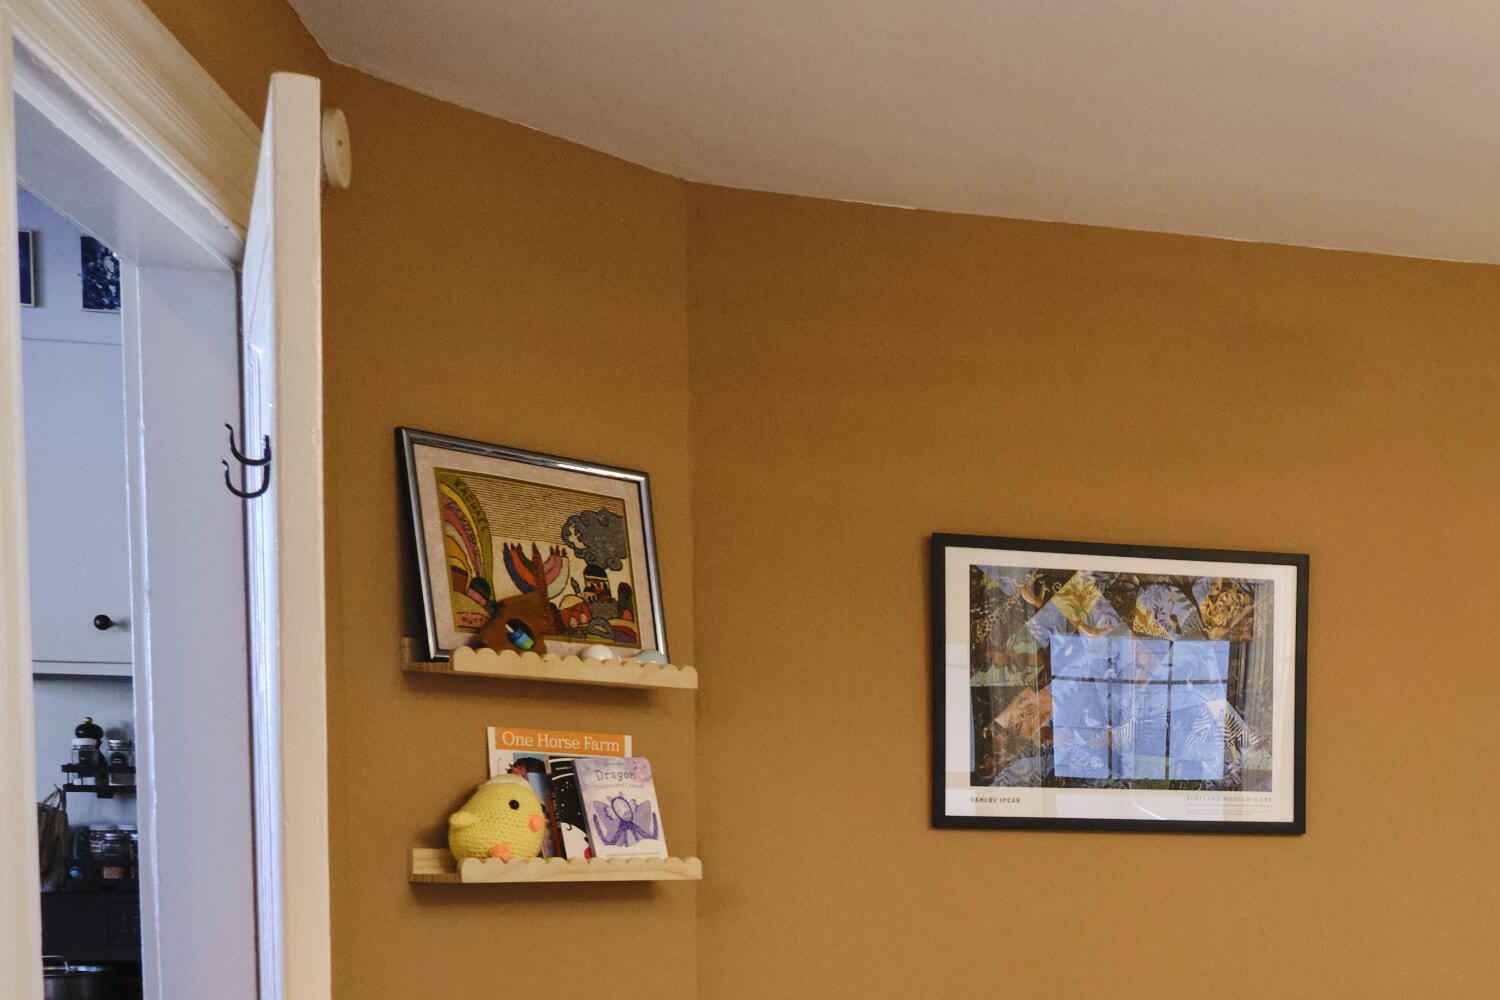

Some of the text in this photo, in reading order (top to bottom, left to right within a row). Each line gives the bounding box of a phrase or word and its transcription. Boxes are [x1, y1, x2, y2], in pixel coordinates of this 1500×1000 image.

[502, 731, 620, 752] One Horse Farm
[595, 770, 636, 782] Dragon
